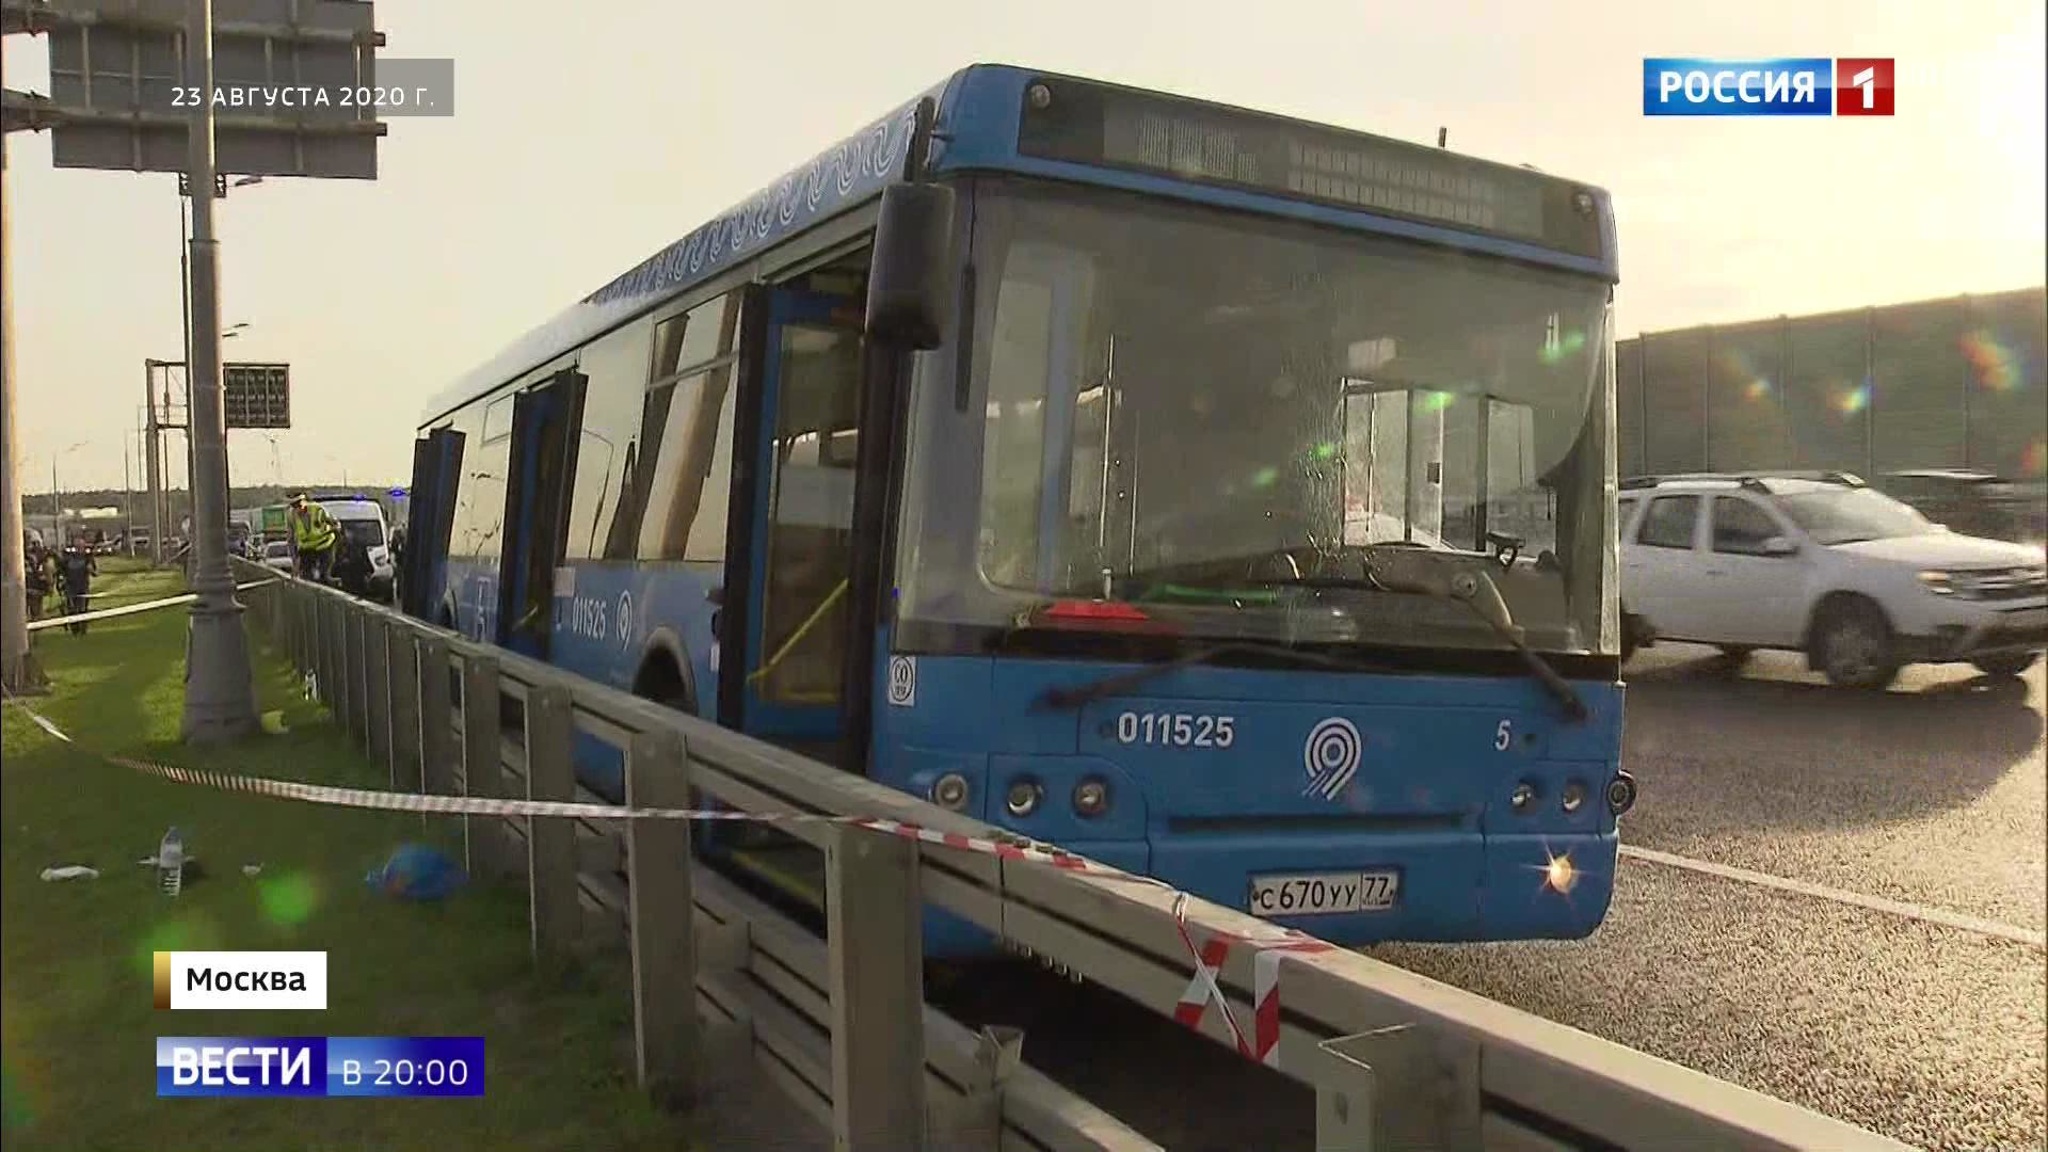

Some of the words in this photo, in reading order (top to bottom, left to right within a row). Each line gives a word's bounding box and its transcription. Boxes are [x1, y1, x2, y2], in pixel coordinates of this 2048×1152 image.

[572, 596, 607, 641] 011525
[1117, 711, 1235, 748] 011525
[1494, 719, 1512, 752] 5
[1364, 876, 1390, 898] 77
